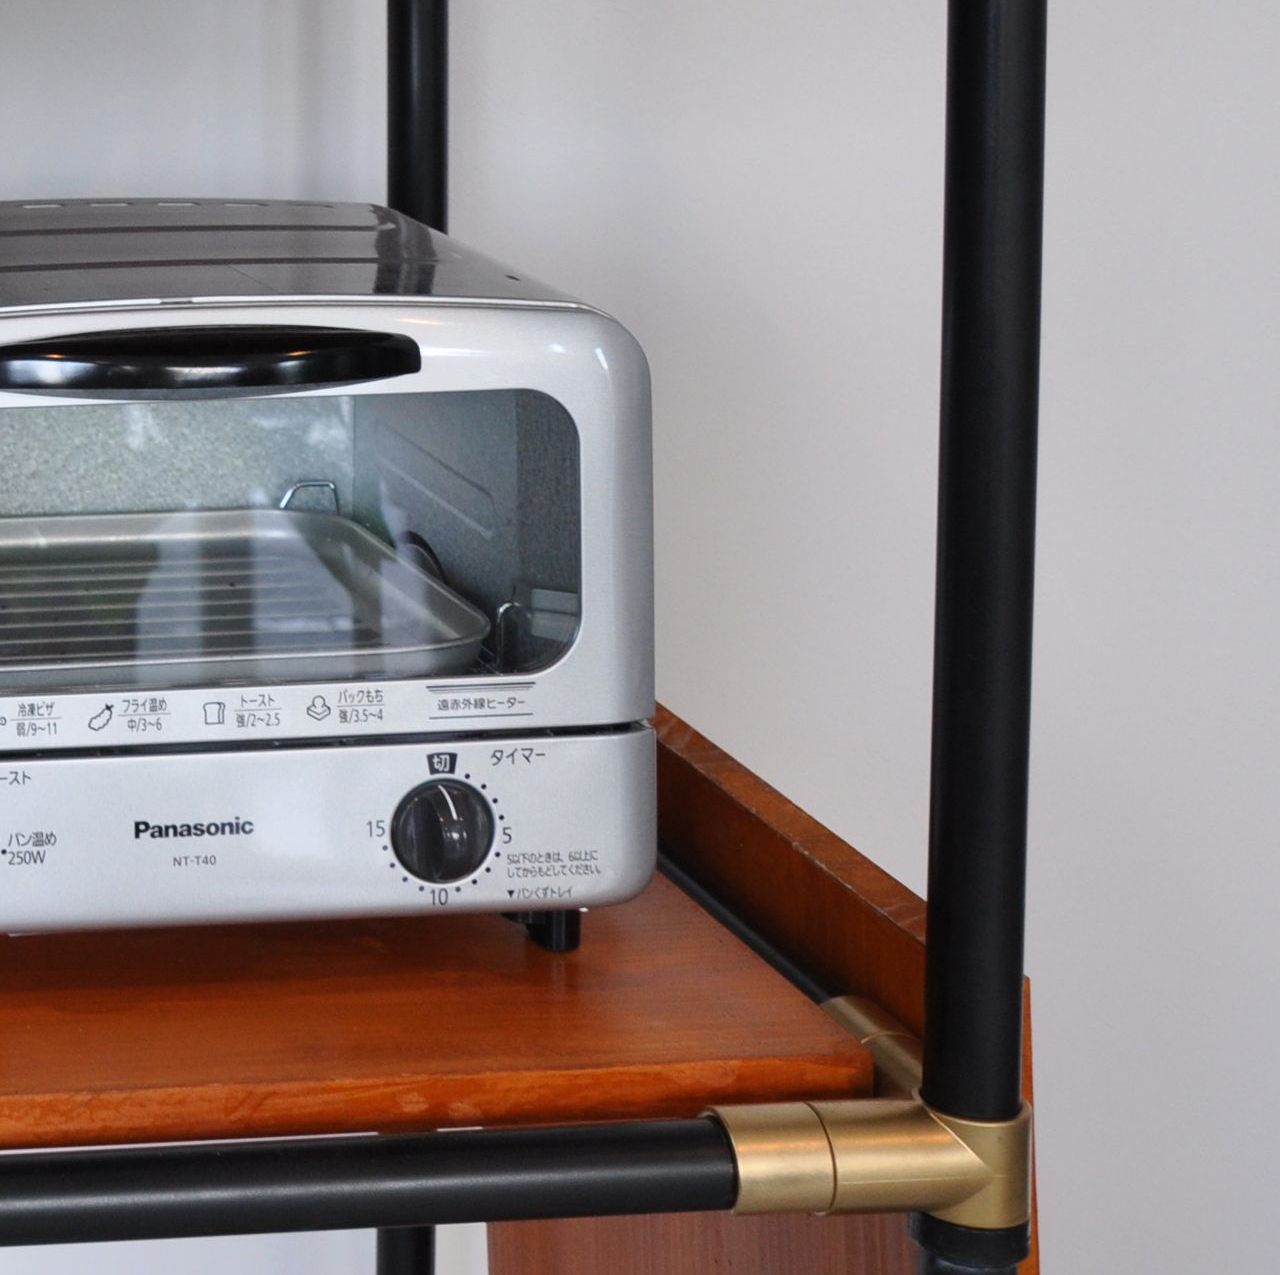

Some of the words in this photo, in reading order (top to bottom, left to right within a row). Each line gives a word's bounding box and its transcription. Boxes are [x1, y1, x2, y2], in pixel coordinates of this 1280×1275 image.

[122, 699, 167, 713] フライ温め
[240, 694, 276, 708] トースト
[18, 702, 55, 717] 冷凍ピザ
[490, 747, 546, 765] タイマー
[432, 756, 450, 772] 切
[134, 817, 254, 839] Panasonic
[366, 820, 385, 837] 15
[502, 827, 512, 844] 5
[8, 832, 57, 847] パン温め
[8, 850, 46, 865] 250W
[173, 855, 216, 866] NT-T40
[430, 888, 448, 906] 10
